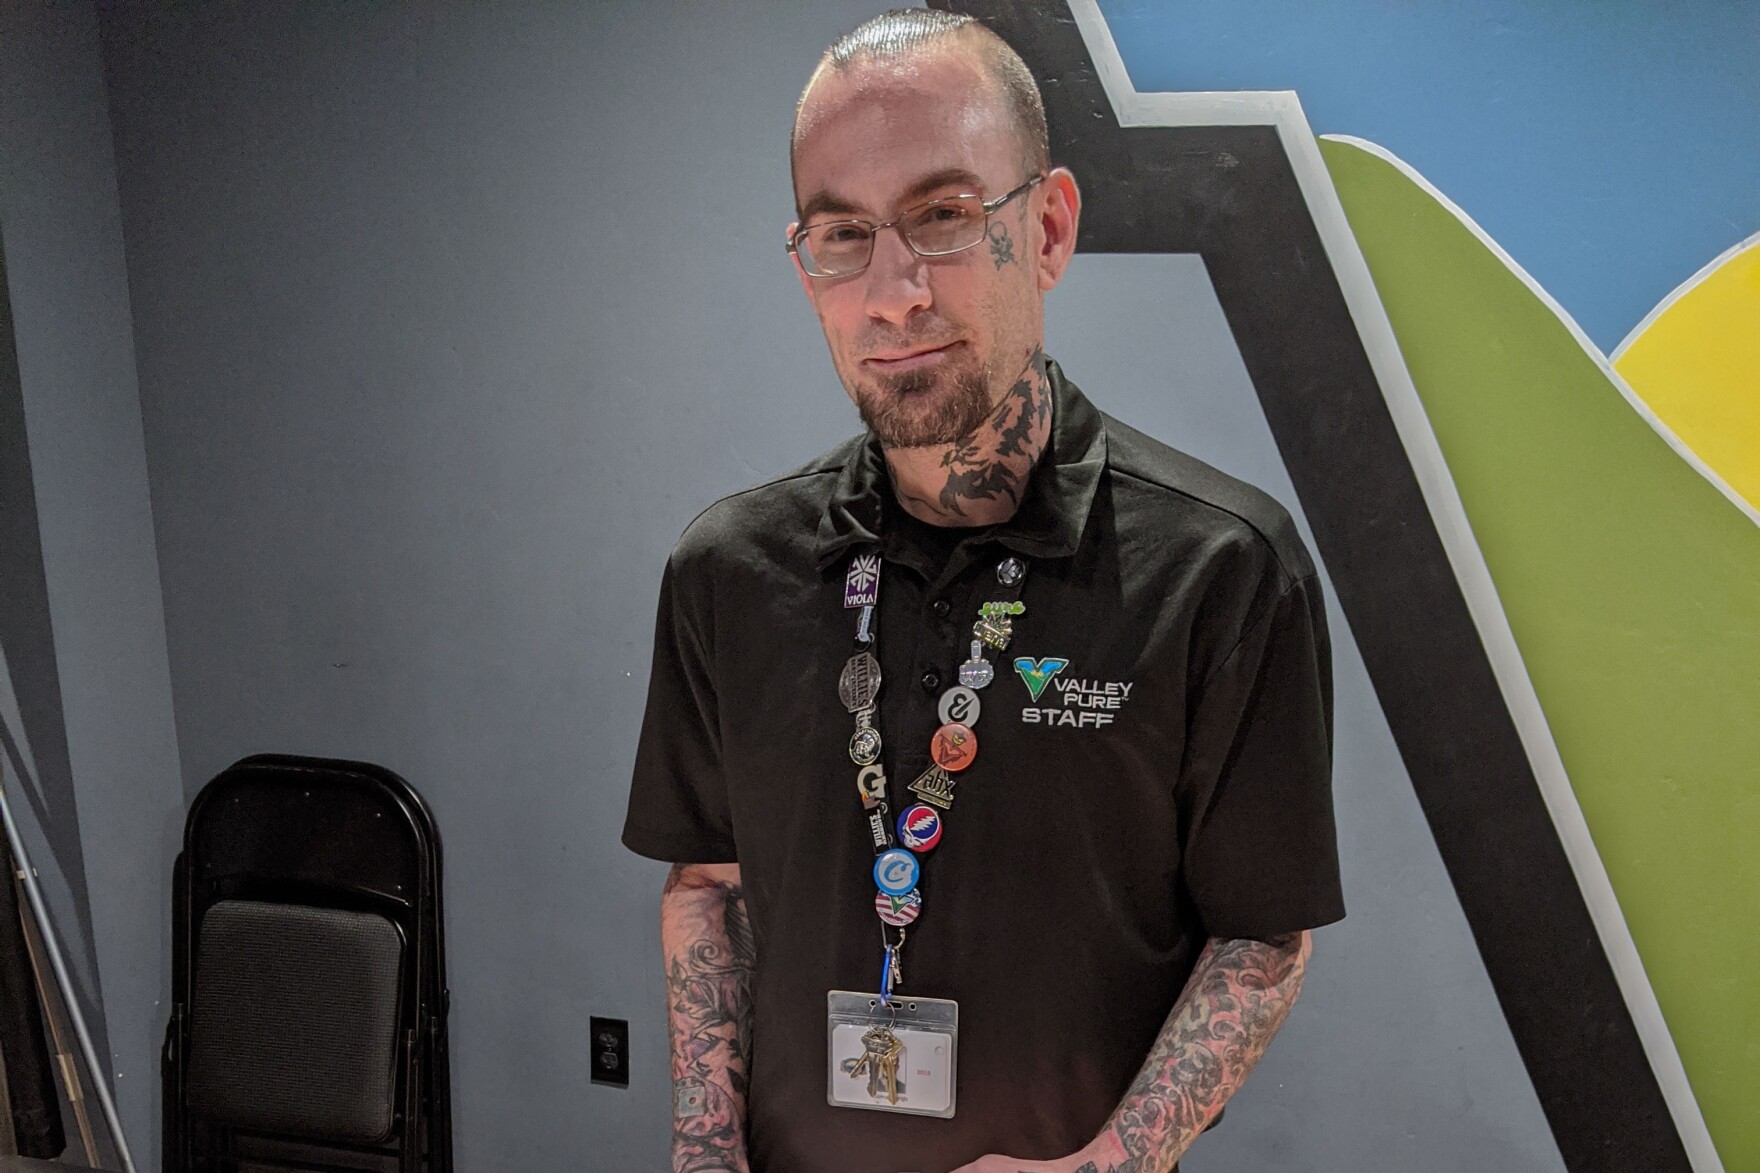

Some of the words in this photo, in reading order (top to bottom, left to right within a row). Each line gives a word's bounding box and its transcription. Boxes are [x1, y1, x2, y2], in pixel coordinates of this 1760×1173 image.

[847, 593, 874, 606] VIOLA
[1054, 677, 1133, 697] VALLEY
[1022, 707, 1114, 729] STAFF
